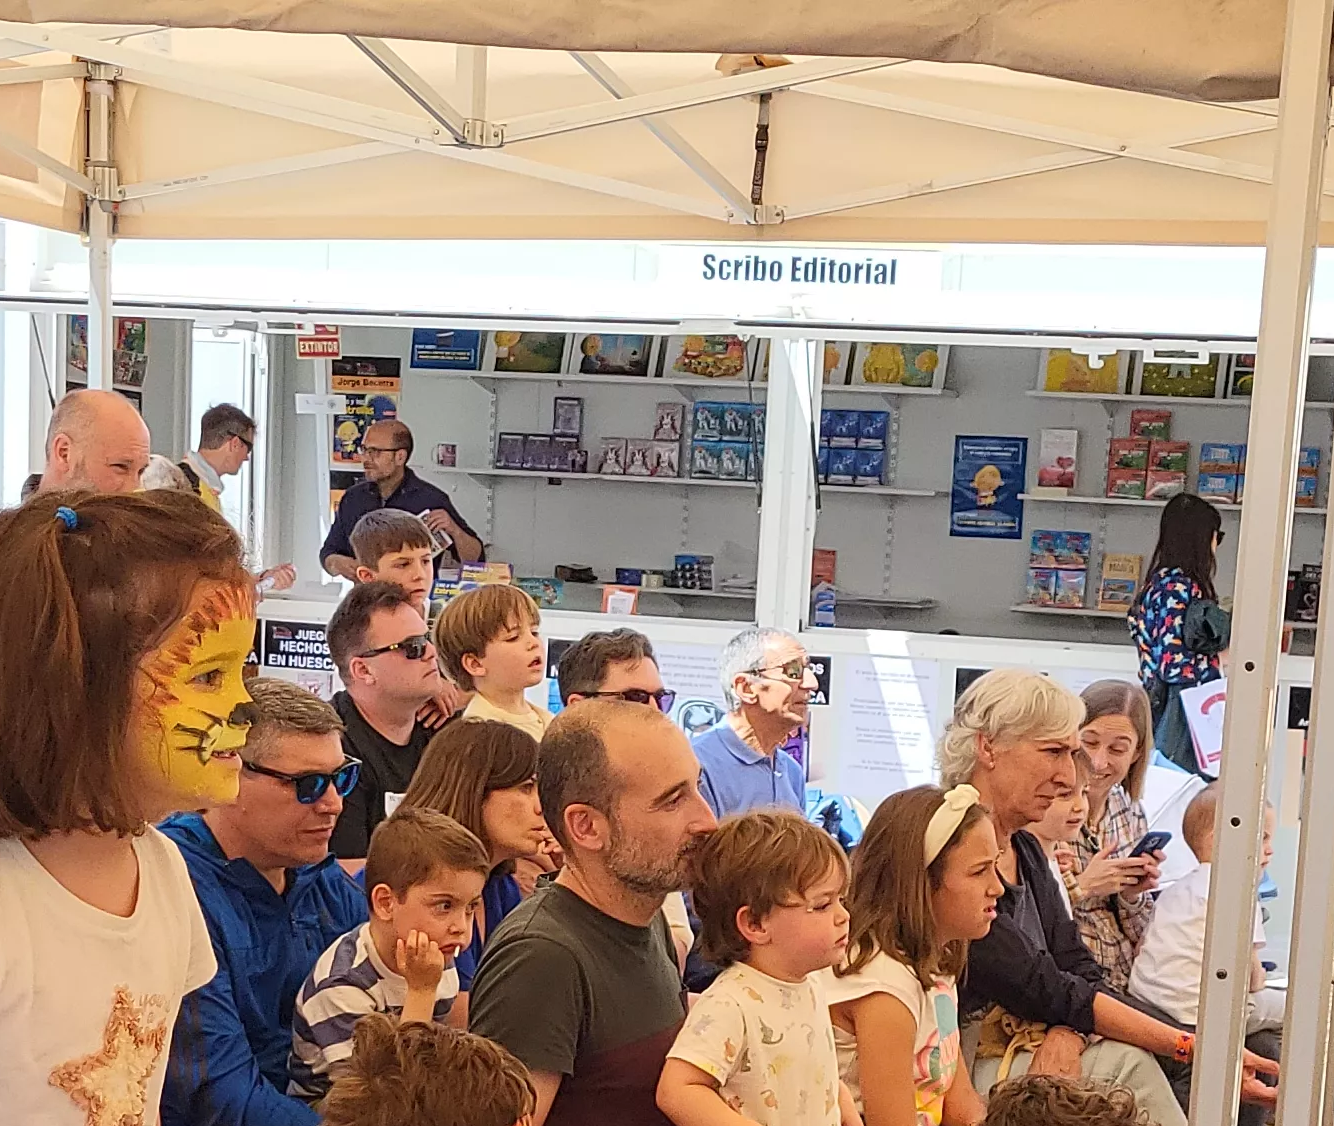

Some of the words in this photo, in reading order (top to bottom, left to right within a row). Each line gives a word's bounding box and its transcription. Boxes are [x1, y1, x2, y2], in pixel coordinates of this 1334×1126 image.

[702, 253, 784, 282] Scribo
[790, 256, 898, 285] Editorial
[299, 340, 339, 354] EXTINTOR
[294, 629, 328, 641] JUEG
[279, 640, 331, 655] HECHOS
[268, 654, 286, 666] EN
